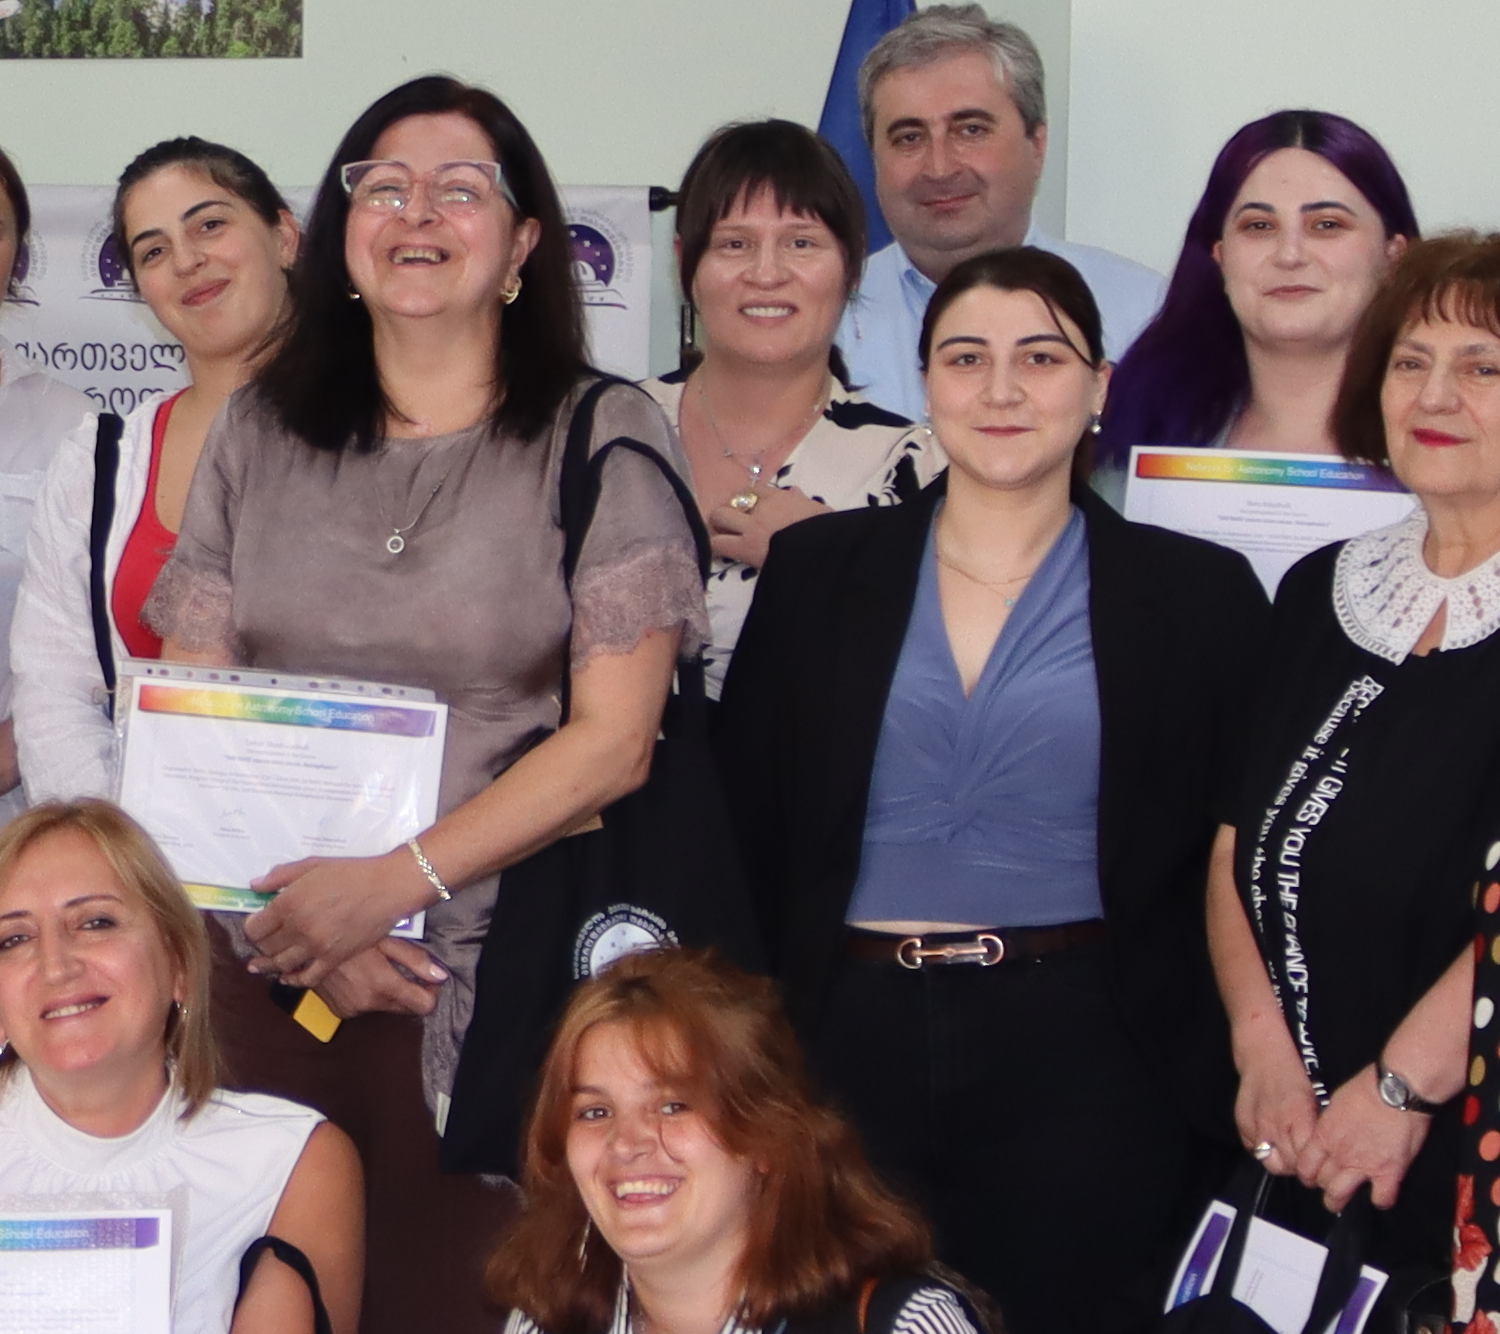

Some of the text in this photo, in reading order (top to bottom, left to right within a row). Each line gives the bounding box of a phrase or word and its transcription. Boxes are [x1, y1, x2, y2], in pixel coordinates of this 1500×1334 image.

[1238, 465, 1285, 477] Astronomy
[1286, 466, 1318, 478] School
[1319, 468, 1365, 481] Education
[1313, 680, 1361, 745] Because
[1302, 745, 1325, 761] it
[1274, 760, 1309, 806] gives
[1295, 776, 1344, 826] GIVES
[1279, 828, 1313, 868] YOU
[1277, 872, 1300, 911] THE
[36, 1227, 90, 1239] Education
